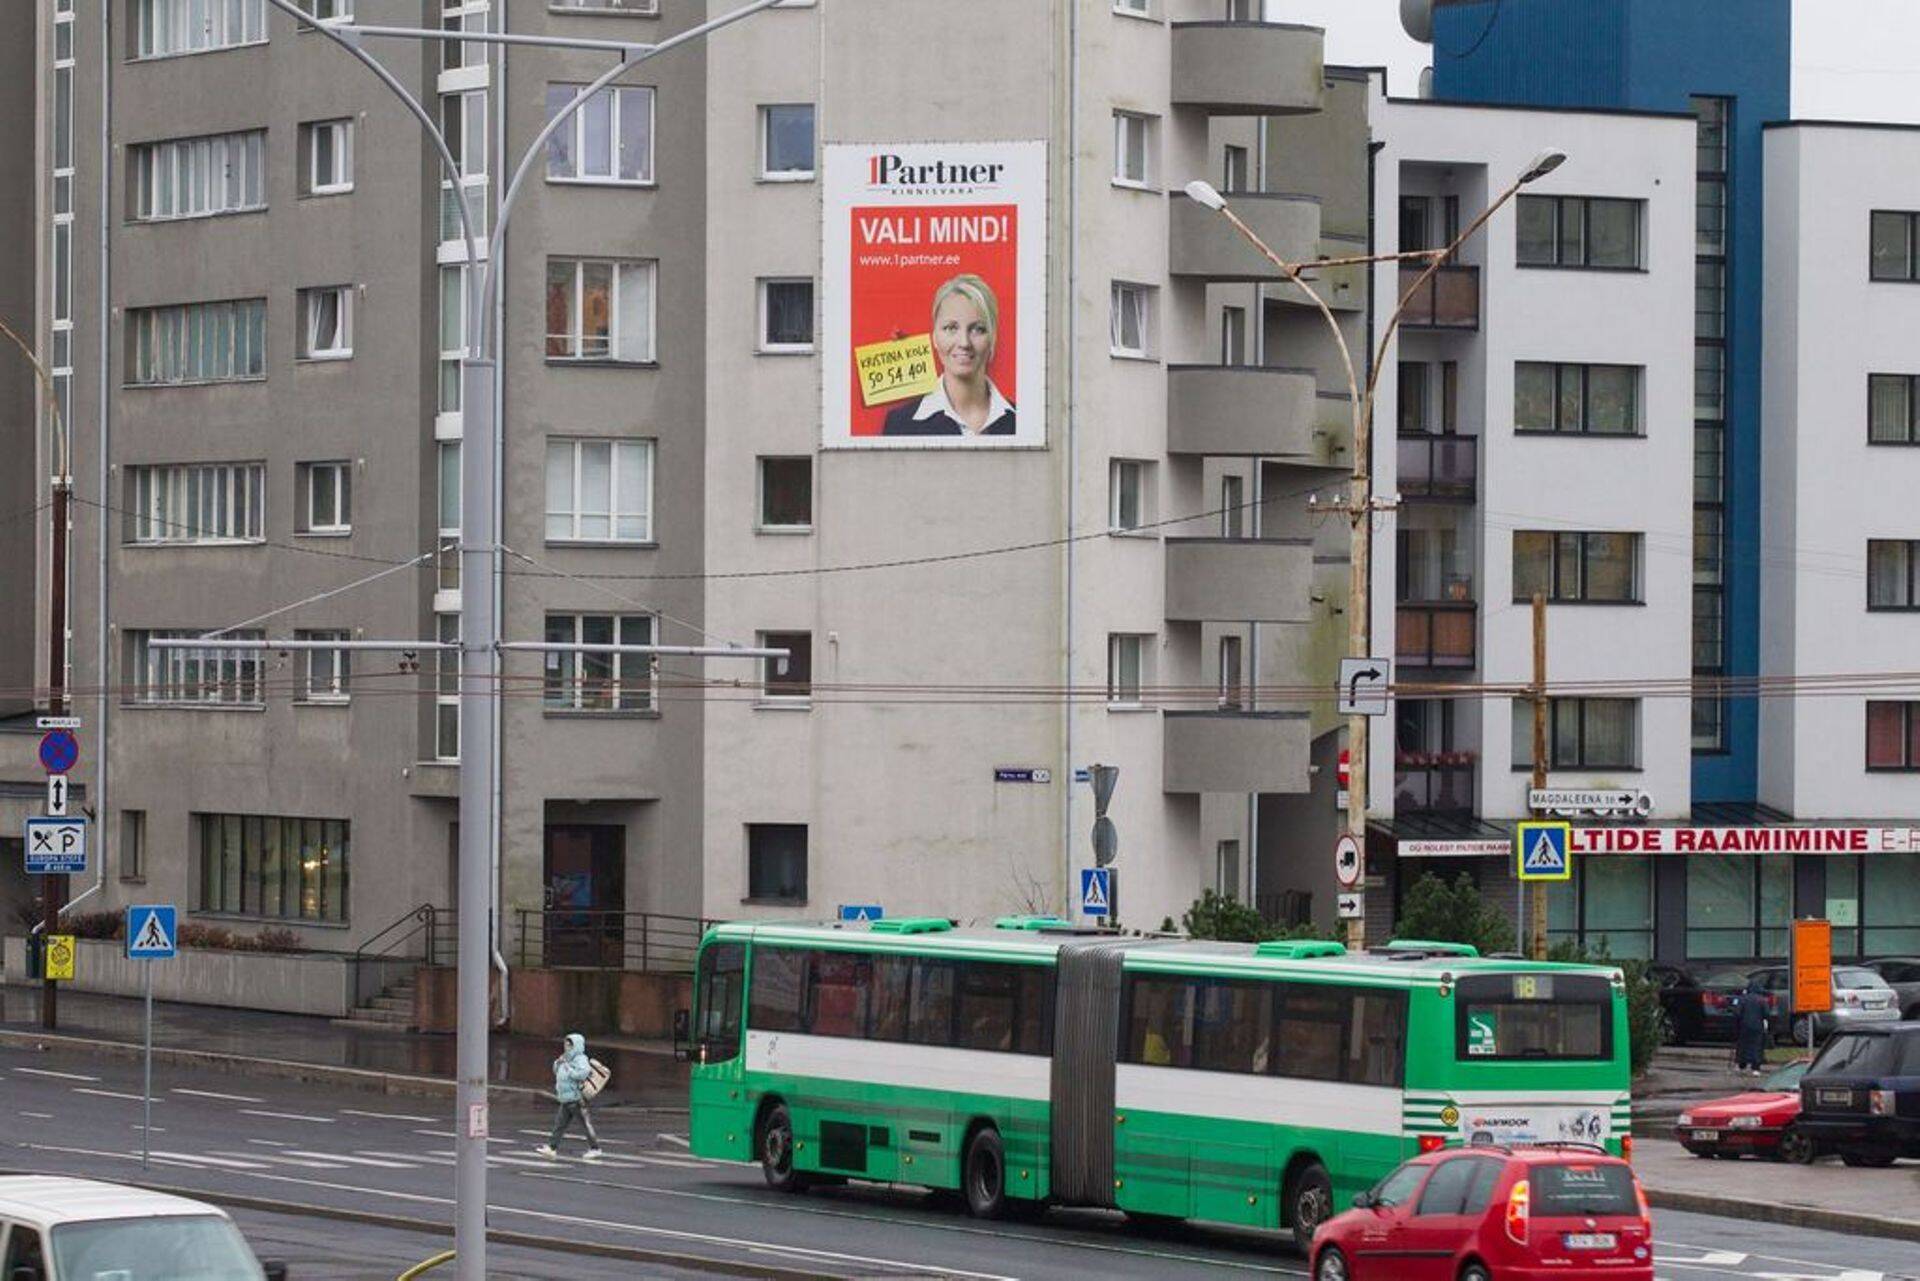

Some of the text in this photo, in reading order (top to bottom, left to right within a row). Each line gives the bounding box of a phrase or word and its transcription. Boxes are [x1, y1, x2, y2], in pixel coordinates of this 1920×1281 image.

[867, 154, 1003, 184] 1Partner
[859, 215, 1008, 244] VALI MIND!
[859, 254, 960, 266] www.1partner.ee
[868, 361, 927, 389] 50 54 401
[1532, 793, 1601, 804] MAGDALEENA
[1570, 829, 1661, 851] LTIDE
[1674, 829, 1868, 851] RAAMIMINE
